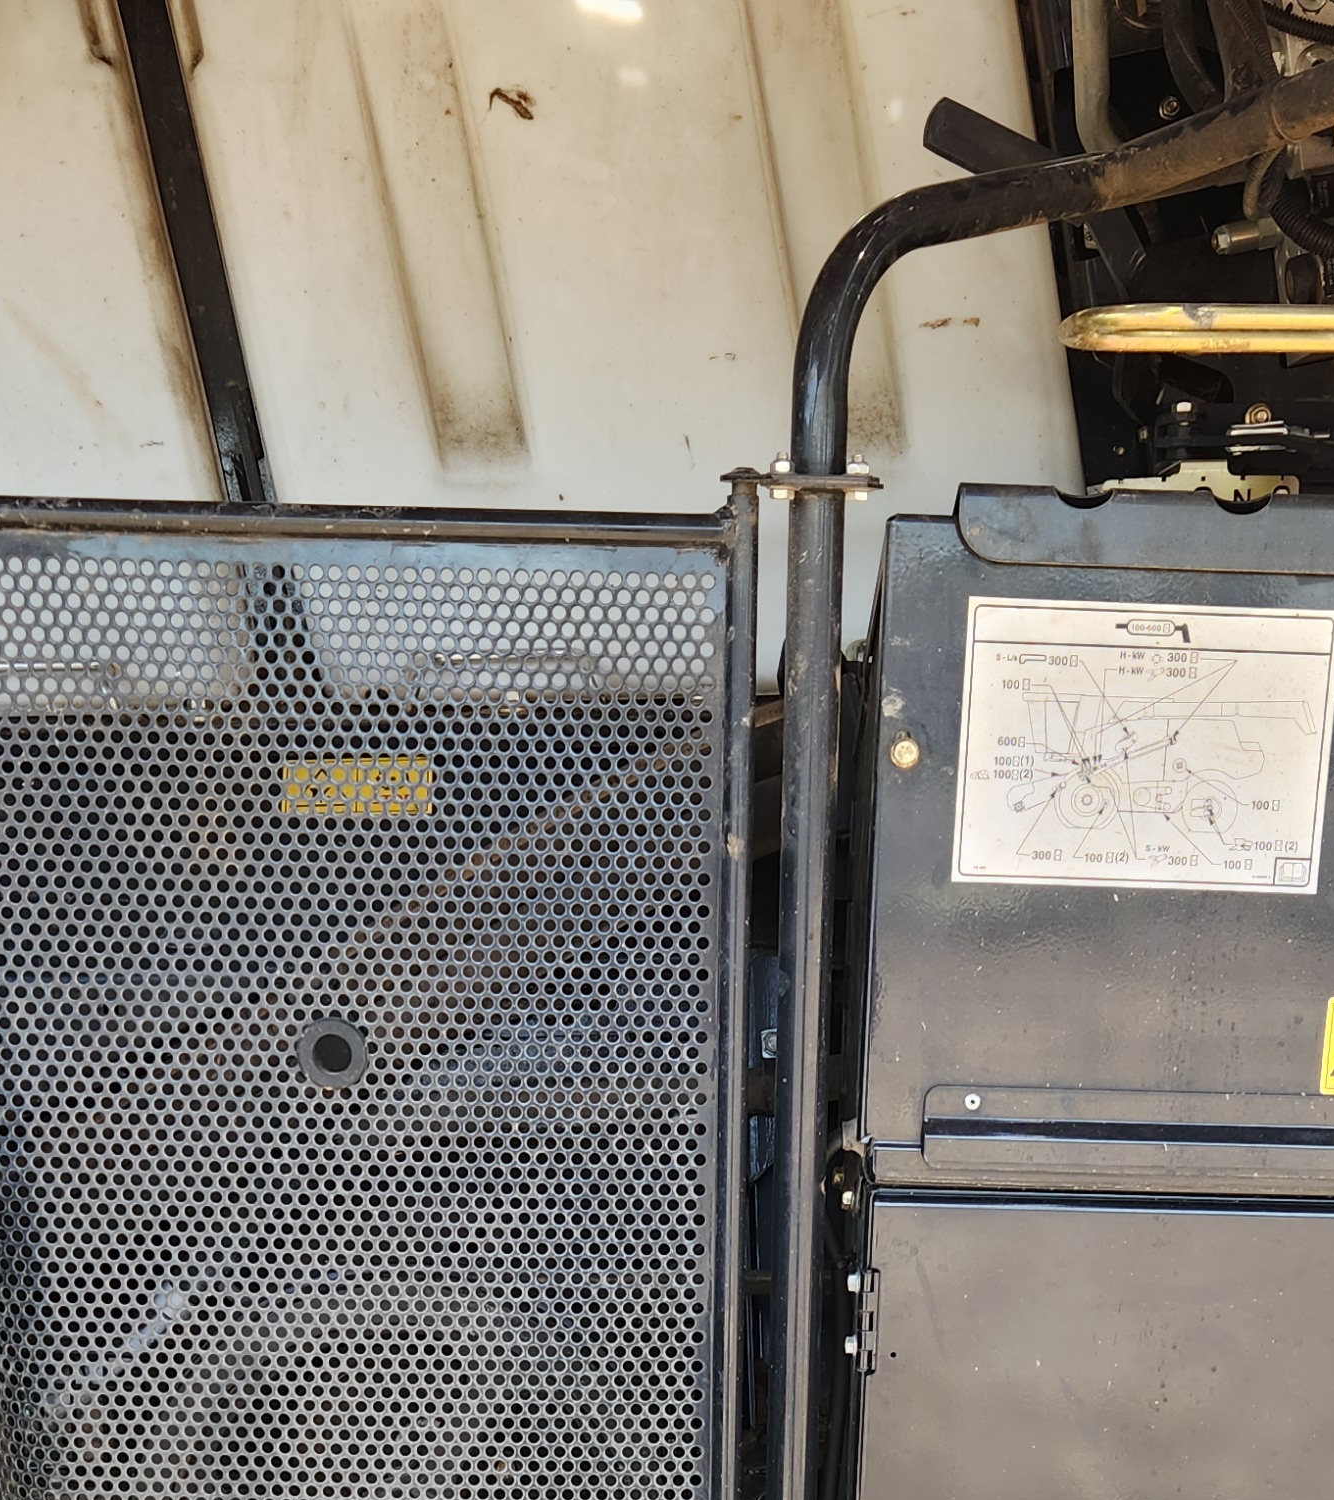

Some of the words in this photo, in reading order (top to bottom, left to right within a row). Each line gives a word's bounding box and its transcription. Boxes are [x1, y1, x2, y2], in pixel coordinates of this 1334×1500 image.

[1047, 655, 1068, 666] 300
[1166, 652, 1188, 663] 300
[1165, 667, 1186, 678] 300
[1002, 679, 1020, 690] 100
[997, 736, 1017, 746] 600
[994, 756, 1012, 766] 100
[993, 769, 1011, 779] 100
[1251, 800, 1270, 811] 100
[1254, 840, 1273, 851] 100
[1031, 850, 1052, 861] 300
[1084, 853, 1103, 863] 100
[1167, 855, 1188, 867] 300
[1223, 860, 1242, 870] 100
